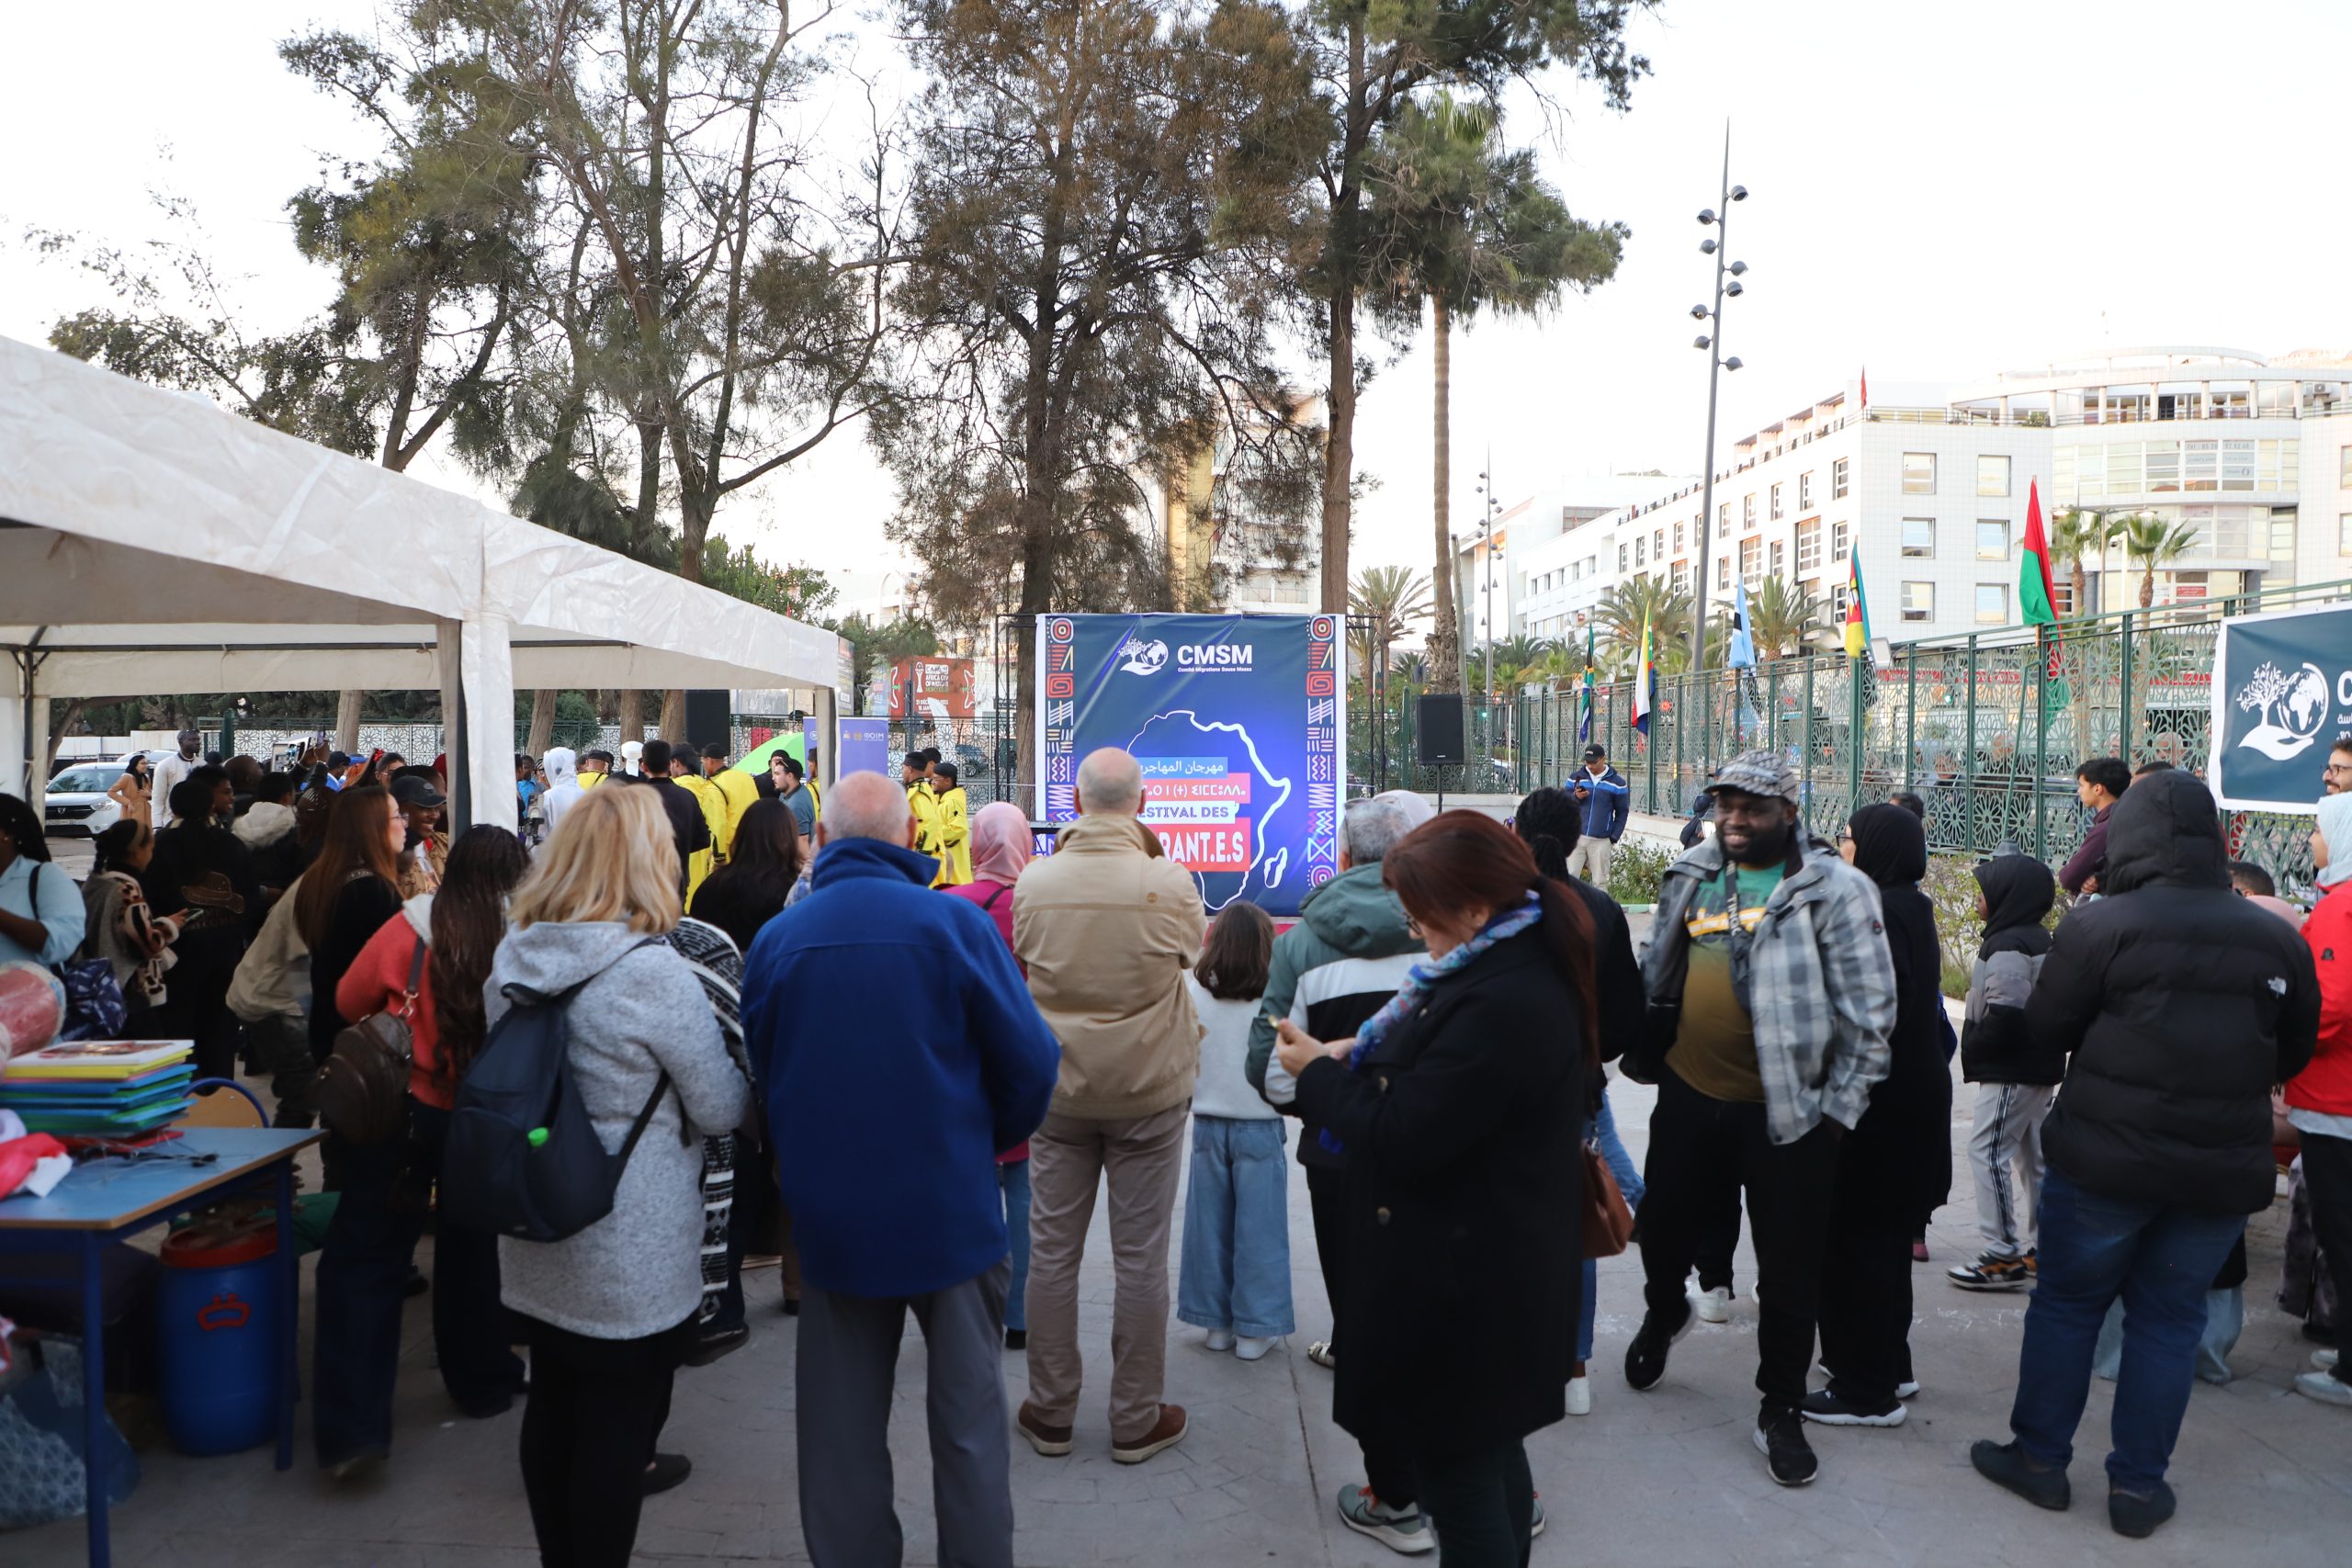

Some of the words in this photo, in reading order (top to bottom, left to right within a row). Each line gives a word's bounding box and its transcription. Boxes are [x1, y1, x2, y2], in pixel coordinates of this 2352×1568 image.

[1177, 644, 1252, 665] CMSM
[1184, 760, 1224, 774] مهرجان
[1201, 807, 1229, 818] DES
[1159, 830, 1245, 863] RANT.E.S
